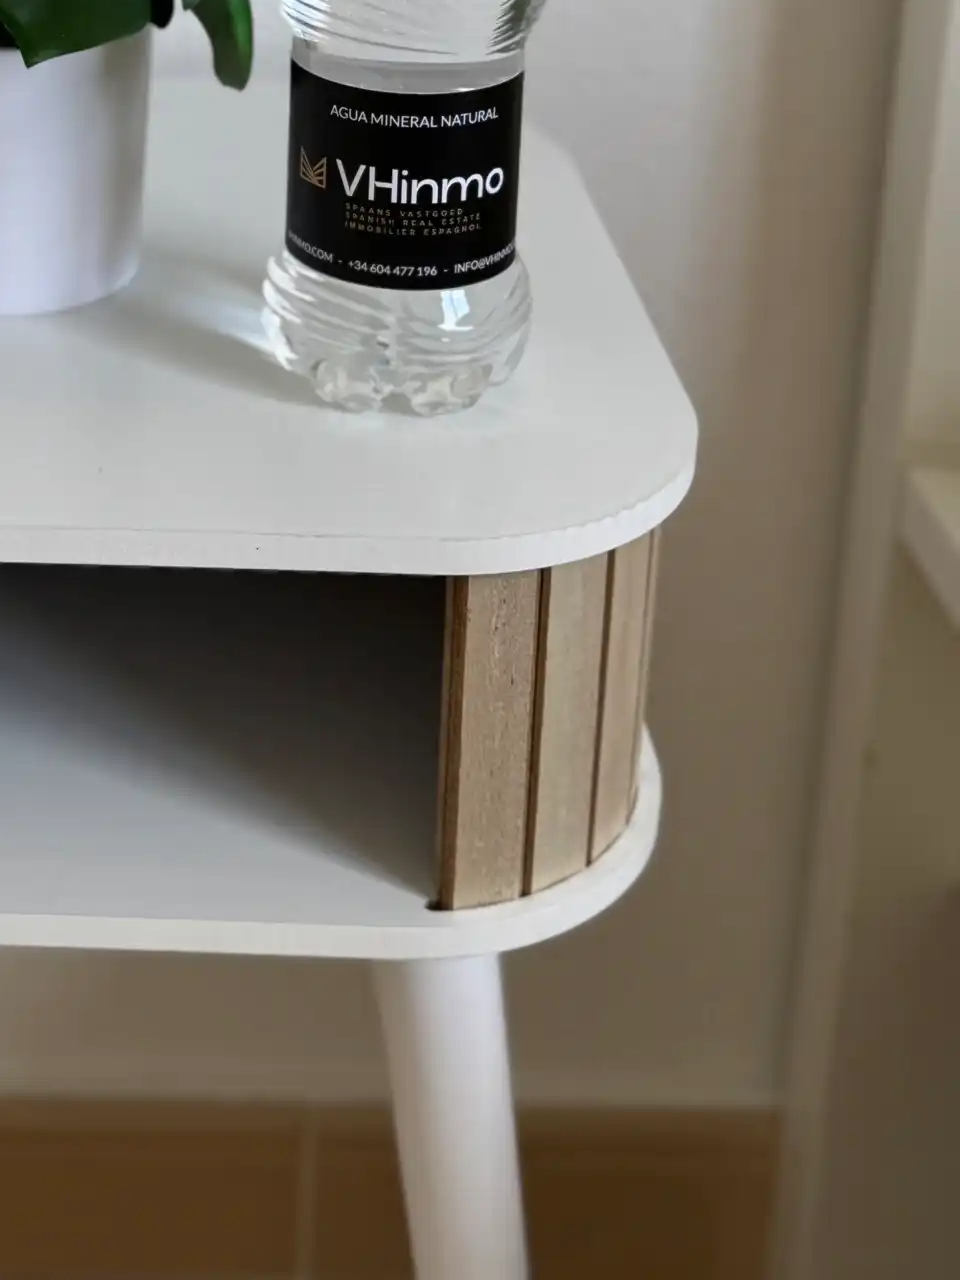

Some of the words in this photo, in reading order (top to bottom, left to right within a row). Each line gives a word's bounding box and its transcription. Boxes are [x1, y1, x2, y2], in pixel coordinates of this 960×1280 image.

[330, 104, 368, 124] AGUA
[370, 112, 438, 128] MINERAL
[441, 107, 499, 128] NATURAL
[335, 158, 504, 204] VHinmo
[344, 202, 391, 217] SPAANS
[400, 207, 464, 218] VASTGOED
[344, 211, 395, 226] SPANISH
[441, 212, 481, 226] ESTATE
[344, 221, 416, 236] IMMOBILIER
[423, 223, 482, 236] ESPAGNOL
[348, 260, 368, 272] +34
[369, 263, 391, 275] 604
[392, 266, 415, 276] 477
[416, 265, 438, 277] 196
